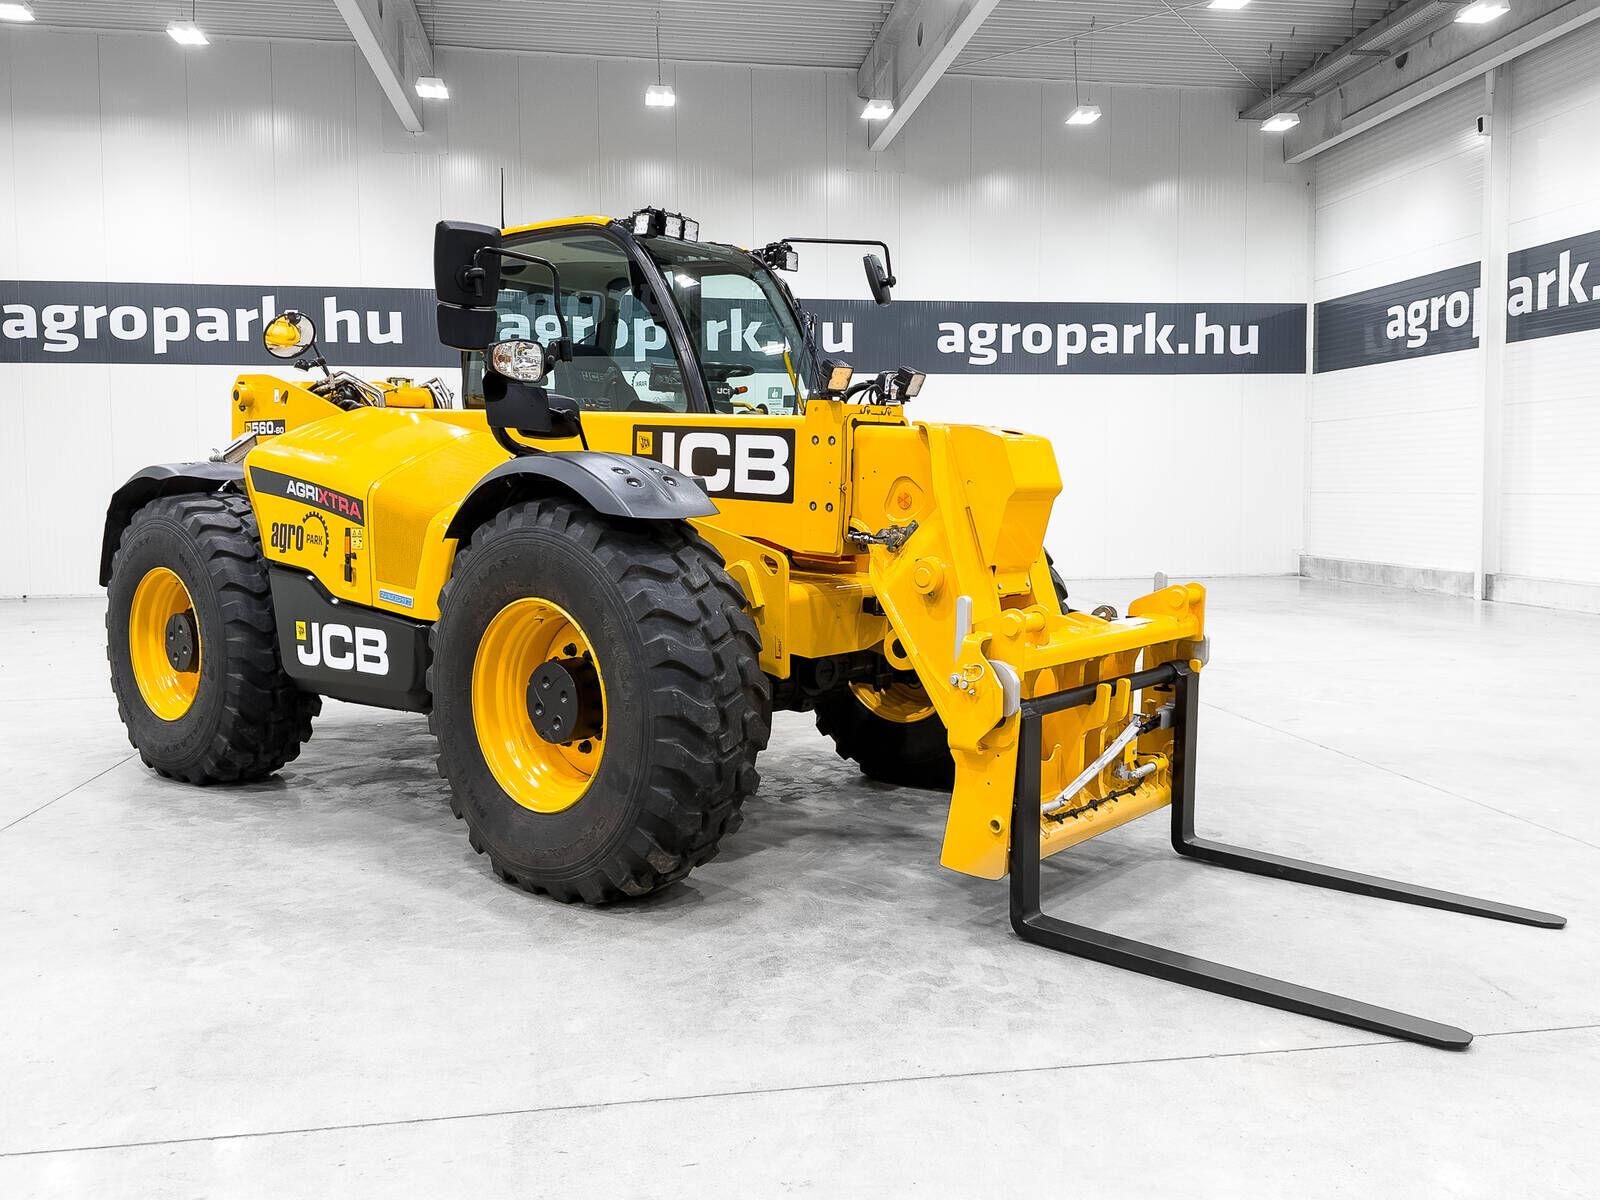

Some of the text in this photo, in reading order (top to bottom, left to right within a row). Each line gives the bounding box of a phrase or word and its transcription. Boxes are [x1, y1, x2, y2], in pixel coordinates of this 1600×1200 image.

[2, 294, 403, 355] agroparhu
[936, 311, 1259, 366] agropark.hu
[286, 480, 362, 520] AGRIXTRA
[271, 521, 323, 554] agro PARK
[296, 622, 390, 676] JCB
